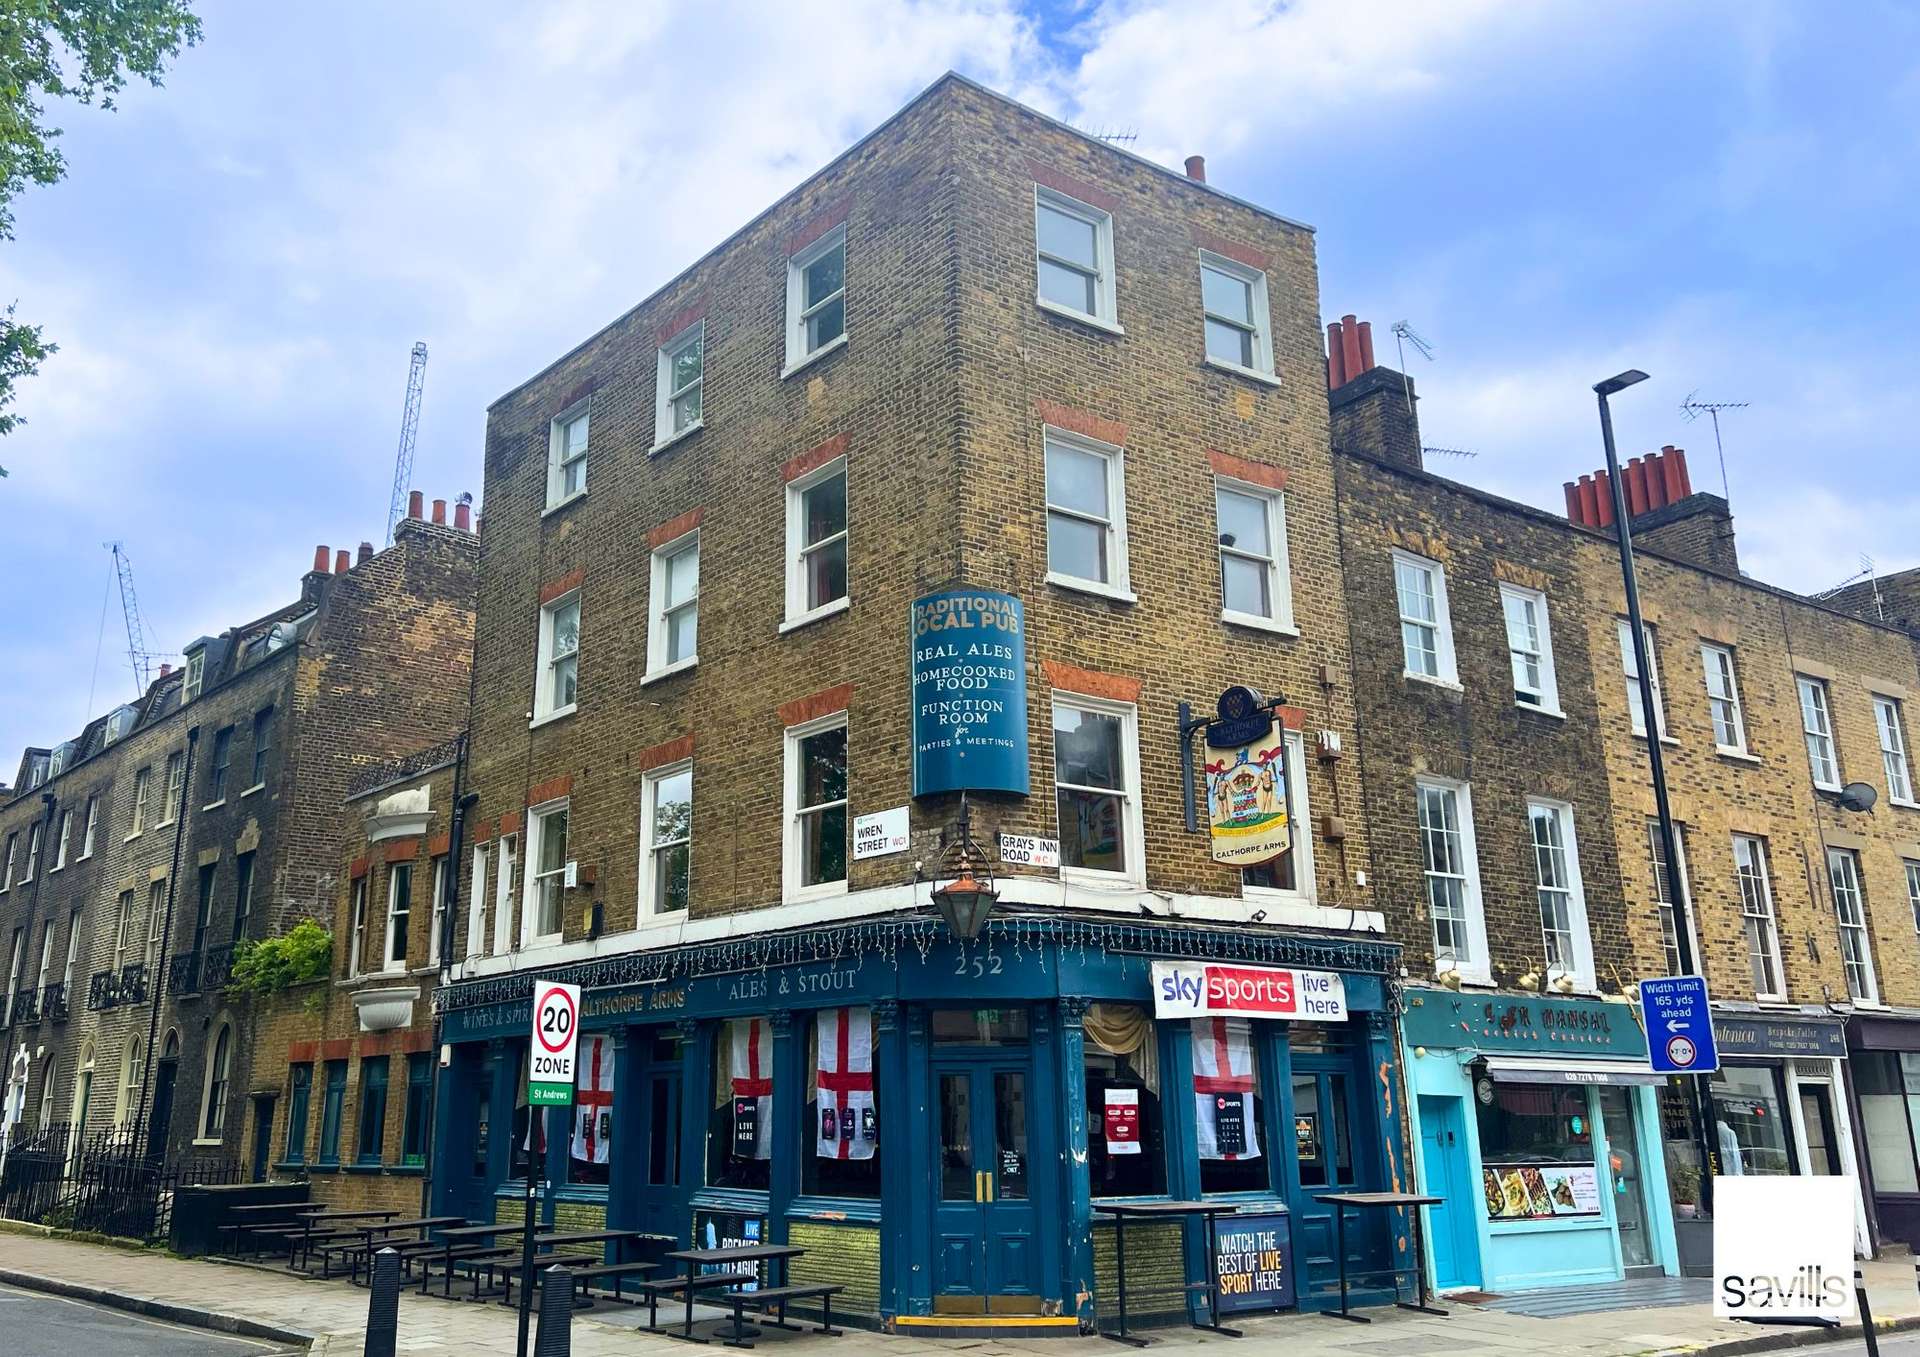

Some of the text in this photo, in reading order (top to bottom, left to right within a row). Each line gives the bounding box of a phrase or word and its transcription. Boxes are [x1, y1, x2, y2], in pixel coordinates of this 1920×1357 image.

[914, 597, 1018, 618] RADITIONAL
[981, 611, 1019, 635] PUB
[916, 643, 1013, 664] REAL ALES
[914, 665, 1016, 686] HOMECOOKED
[936, 677, 989, 692] FOOD
[921, 699, 1004, 717] FUNCTION
[939, 712, 989, 725] ROOM
[955, 723, 969, 739] for
[919, 737, 1014, 753] PARTIES & MEETINGS
[857, 823, 883, 839] WREN
[857, 837, 889, 854] STREET
[1001, 835, 1058, 853] GRAYS INN
[1216, 840, 1287, 859] CALTHORPE ARMS
[1001, 848, 1031, 863] ROAD
[954, 955, 1004, 978] 252
[729, 969, 857, 1000] ALES & STOUT
[1161, 969, 1291, 1008] sky sports
[1302, 972, 1329, 993] live
[1645, 981, 1700, 994] Width limit
[580, 990, 685, 1018] ALTHORPE ARMS
[1304, 995, 1339, 1015] here
[1654, 995, 1694, 1007] 165 yds
[462, 1011, 494, 1029] WINES
[505, 1008, 533, 1024] SPIRI
[543, 1006, 570, 1034] 20
[1661, 1007, 1692, 1018] ahead
[534, 1057, 570, 1075] ZONE
[534, 1089, 568, 1100] St Andrews
[745, 1223, 759, 1236] LIVE
[1220, 1231, 1277, 1254] WATCH THE
[1217, 1250, 1282, 1275] BEST OF LIVE
[1220, 1270, 1283, 1295] SPORT HERE
